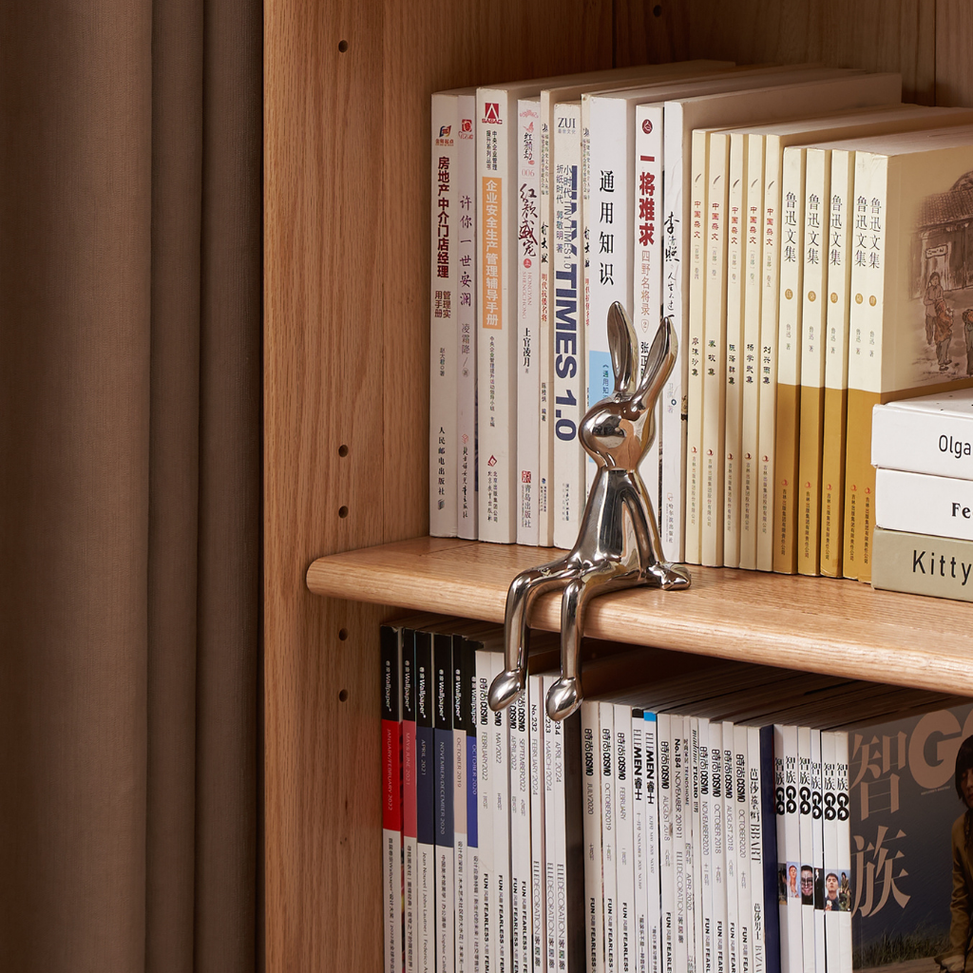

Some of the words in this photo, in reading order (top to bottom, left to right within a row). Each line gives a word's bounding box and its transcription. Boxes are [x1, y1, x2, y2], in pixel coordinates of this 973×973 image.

[557, 117, 577, 129] ZUI
[521, 168, 535, 177] 006
[437, 155, 450, 279] 房地产中介门店经理
[638, 154, 656, 247] 一将难求
[556, 210, 564, 241] 郭敬明
[599, 169, 615, 286] 通用知识
[784, 191, 798, 263] 鲁迅文集
[806, 193, 820, 265] 鲁迅文集
[830, 194, 843, 266] 鲁迅文集
[854, 195, 868, 267] 鲁迅文集
[868, 197, 882, 269] 鲁迅文集
[459, 194, 473, 308] 许你一世安澜
[485, 179, 499, 327] 企业安全生产管理辅导手册
[555, 270, 577, 379] TIMES
[555, 388, 578, 442] 1.0
[437, 426, 446, 496] 人民邮电出版社
[938, 434, 972, 457] Olga
[524, 484, 532, 529] 青岛出版社
[912, 549, 973, 586] Kitty
[555, 741, 563, 761] APRIL
[674, 738, 682, 768] No.184
[786, 756, 796, 784] 智族
[799, 756, 811, 784] 智族
[555, 762, 563, 783] 2024
[675, 771, 683, 813] NOVEMBER
[824, 762, 835, 790] 智族
[836, 762, 849, 791] 智族
[587, 782, 595, 815] JULY2020
[619, 786, 627, 821] FEBRUARY
[800, 786, 811, 815] GQ
[824, 792, 836, 821] GQ
[837, 792, 849, 821] GQ
[702, 800, 710, 856] NOVEMBER2020
[738, 808, 746, 858] OCTOBER2020
[850, 730, 912, 919] 智族
